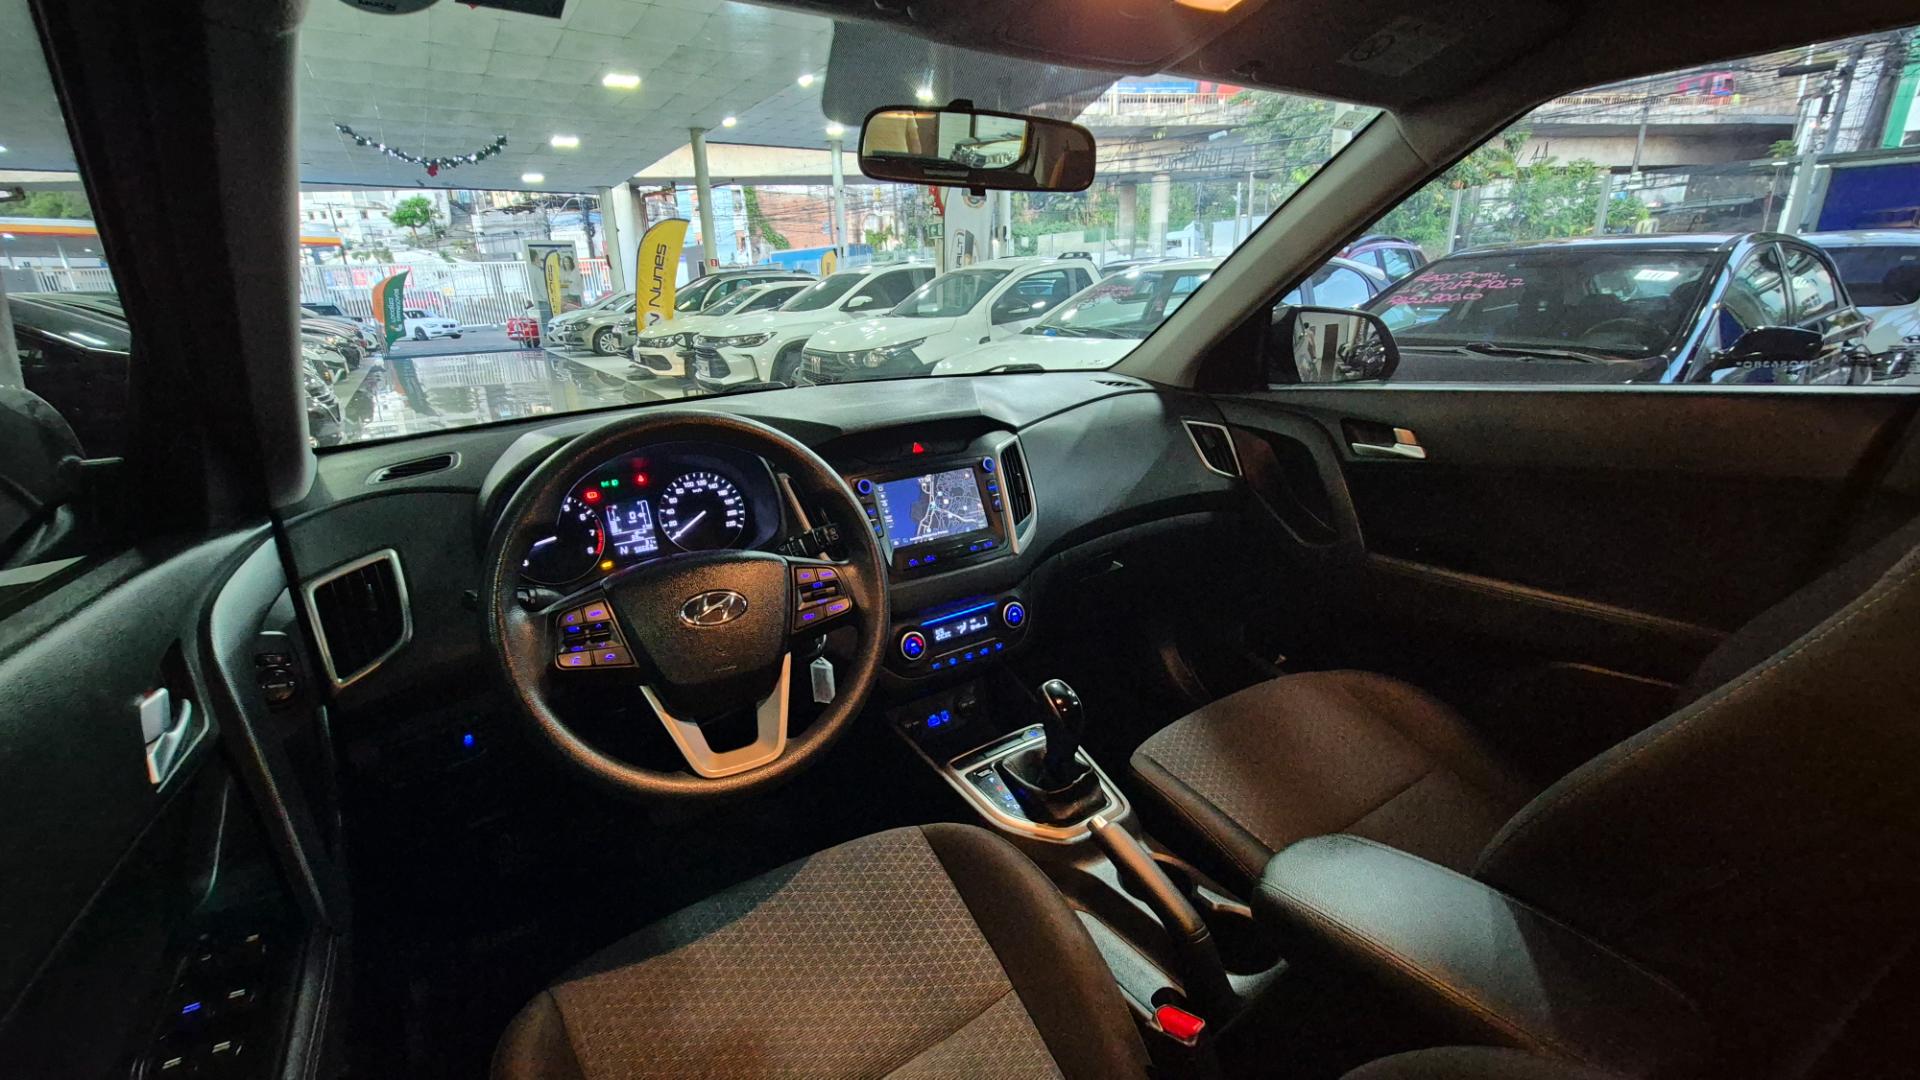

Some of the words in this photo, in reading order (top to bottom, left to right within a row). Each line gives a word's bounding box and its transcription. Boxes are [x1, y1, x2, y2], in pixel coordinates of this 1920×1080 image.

[649, 243, 667, 308] Nunes
[579, 513, 587, 521] 6
[588, 529, 595, 537] 7
[619, 545, 629, 555] N
